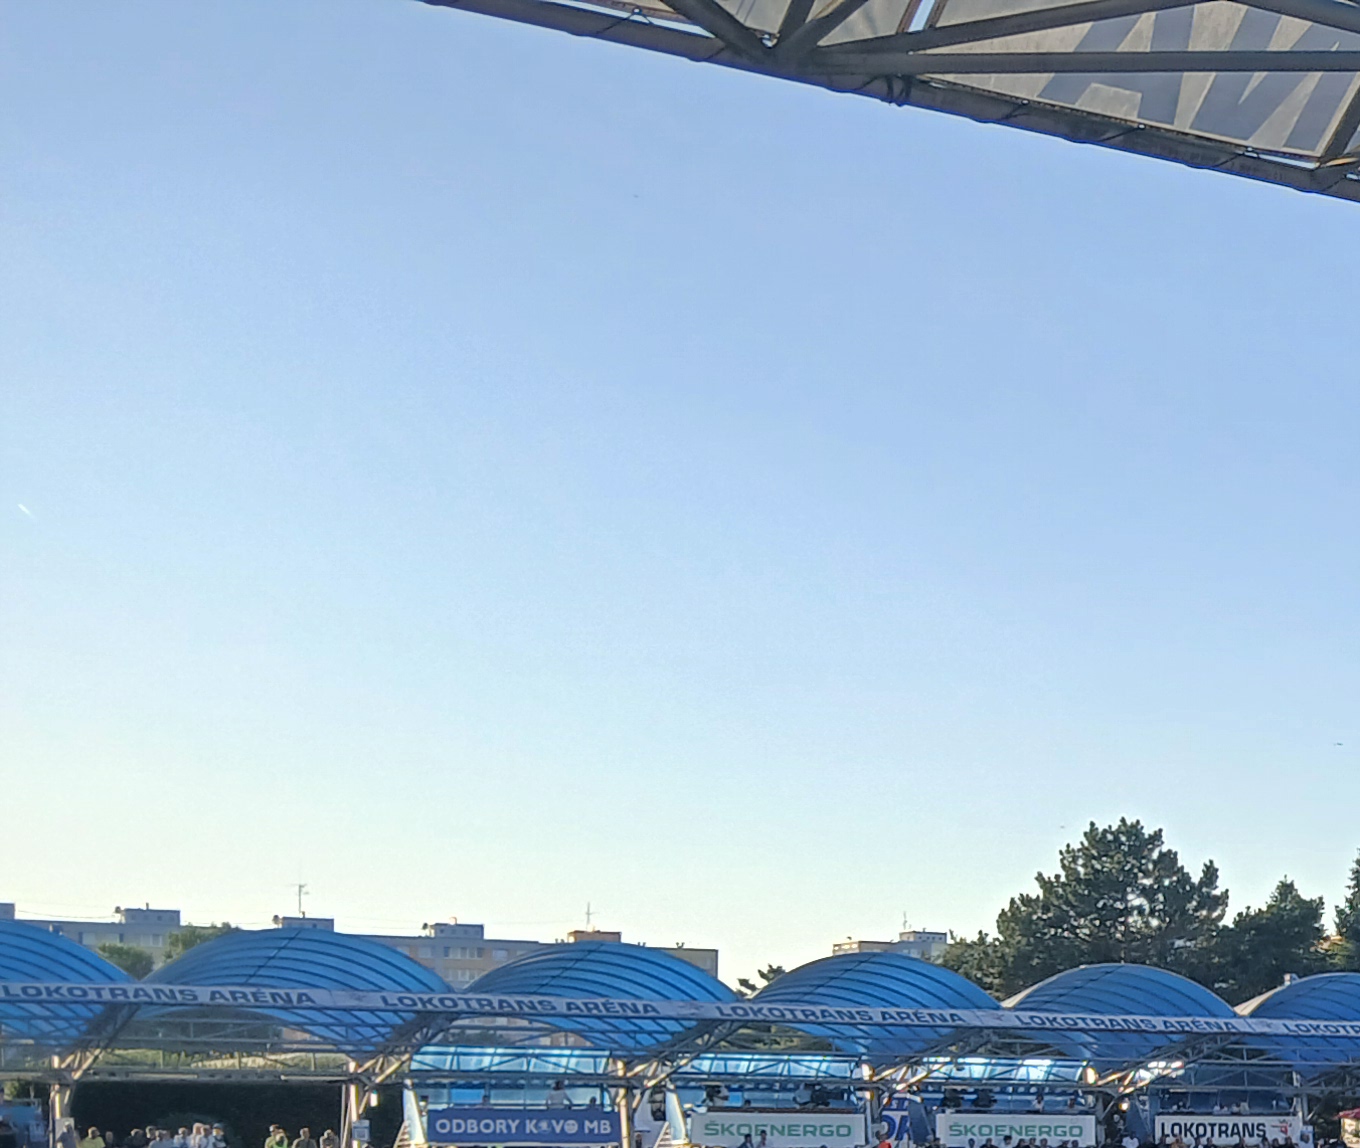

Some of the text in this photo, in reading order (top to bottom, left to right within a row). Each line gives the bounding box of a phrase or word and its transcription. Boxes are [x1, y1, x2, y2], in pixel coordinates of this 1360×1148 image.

[2, 984, 198, 1002] LOKOTRANS
[380, 995, 556, 1012] LOKOTRANS
[716, 1005, 874, 1022] LOKOTRANS
[1016, 1014, 1159, 1031] LOKOTRANS
[435, 1118, 520, 1135] ODBORY
[583, 1118, 612, 1135] MB
[703, 1119, 852, 1138] ŠKOENERGO
[948, 1121, 1083, 1138] ŠKOENERGO
[1160, 1121, 1267, 1139] LOKOTRANS
